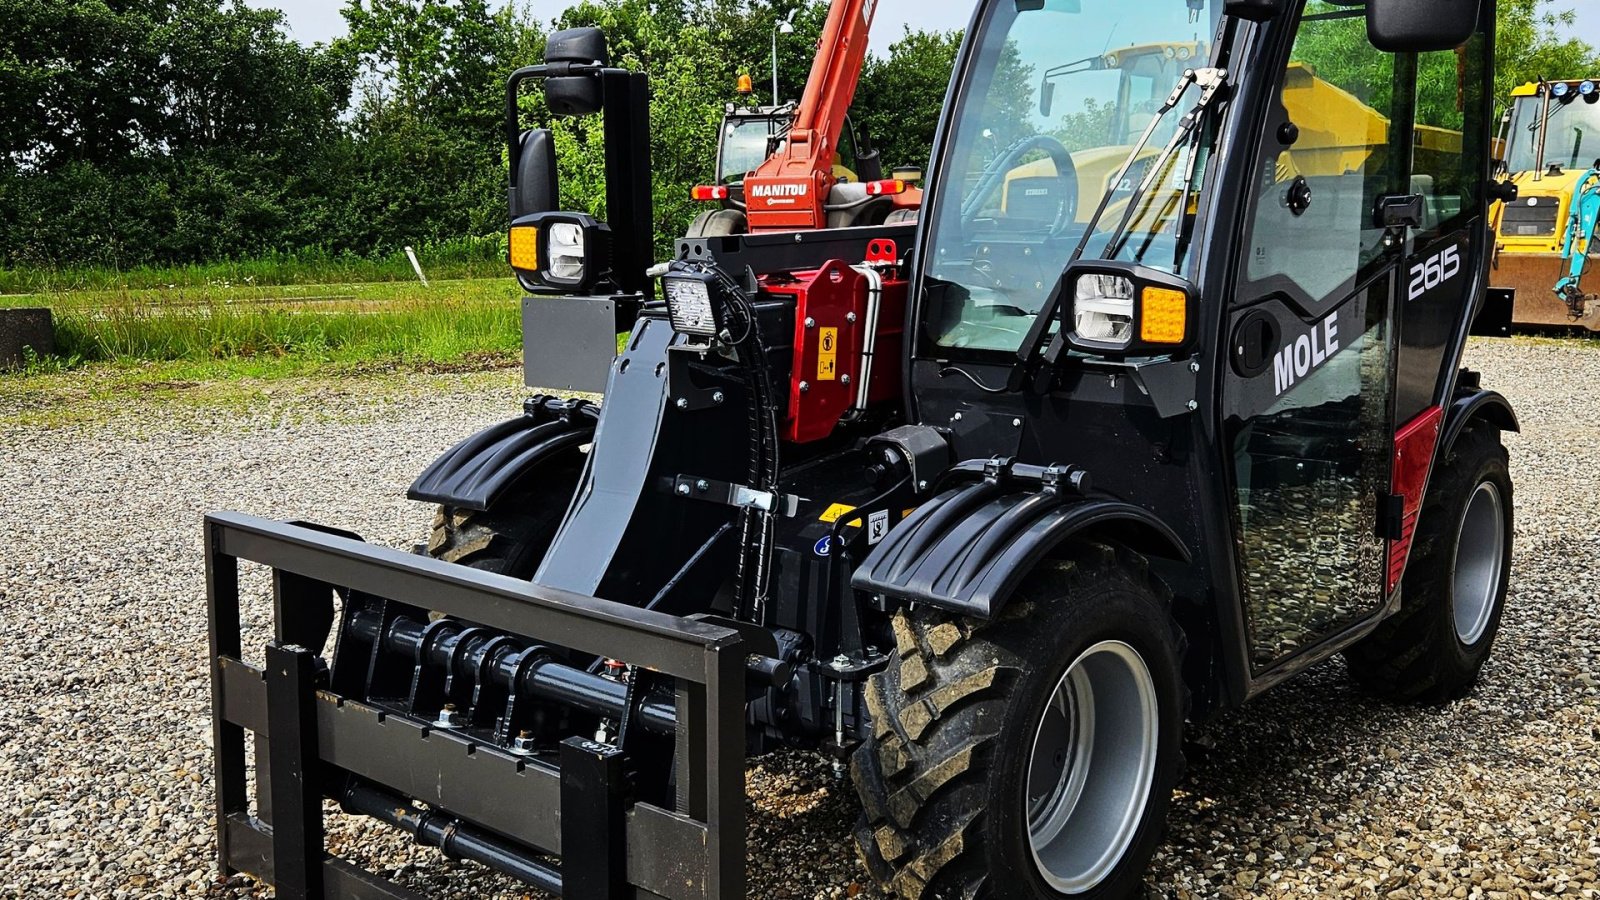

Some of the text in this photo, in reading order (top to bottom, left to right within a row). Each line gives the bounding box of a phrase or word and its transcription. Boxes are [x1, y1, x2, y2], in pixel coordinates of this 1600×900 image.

[752, 184, 807, 197] MANITOU
[1408, 243, 1460, 301] 2615
[1273, 310, 1339, 396] MOLE
